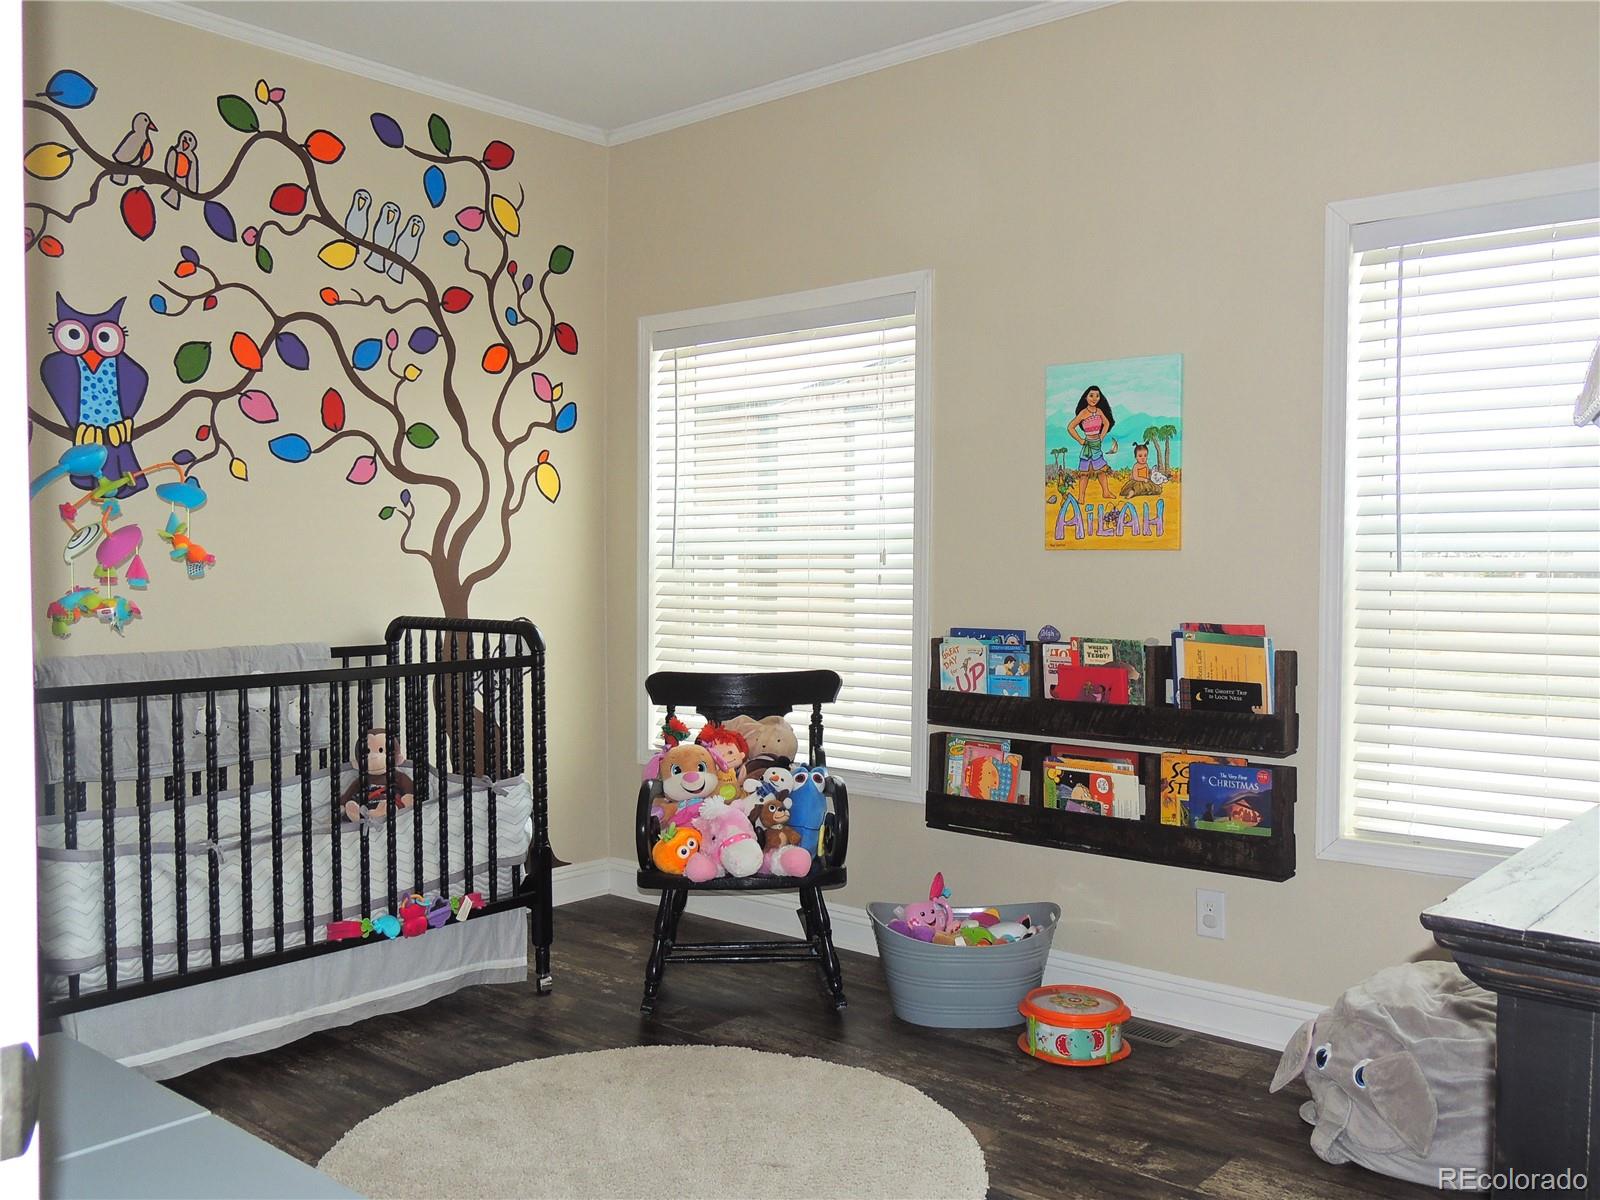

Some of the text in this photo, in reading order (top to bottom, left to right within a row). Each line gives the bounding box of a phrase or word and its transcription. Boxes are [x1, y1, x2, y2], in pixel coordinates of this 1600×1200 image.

[942, 645, 960, 660] GREAT
[943, 656, 957, 670] DAY
[956, 662, 985, 693] UP
[1208, 776, 1260, 791] CHRISTMAS
